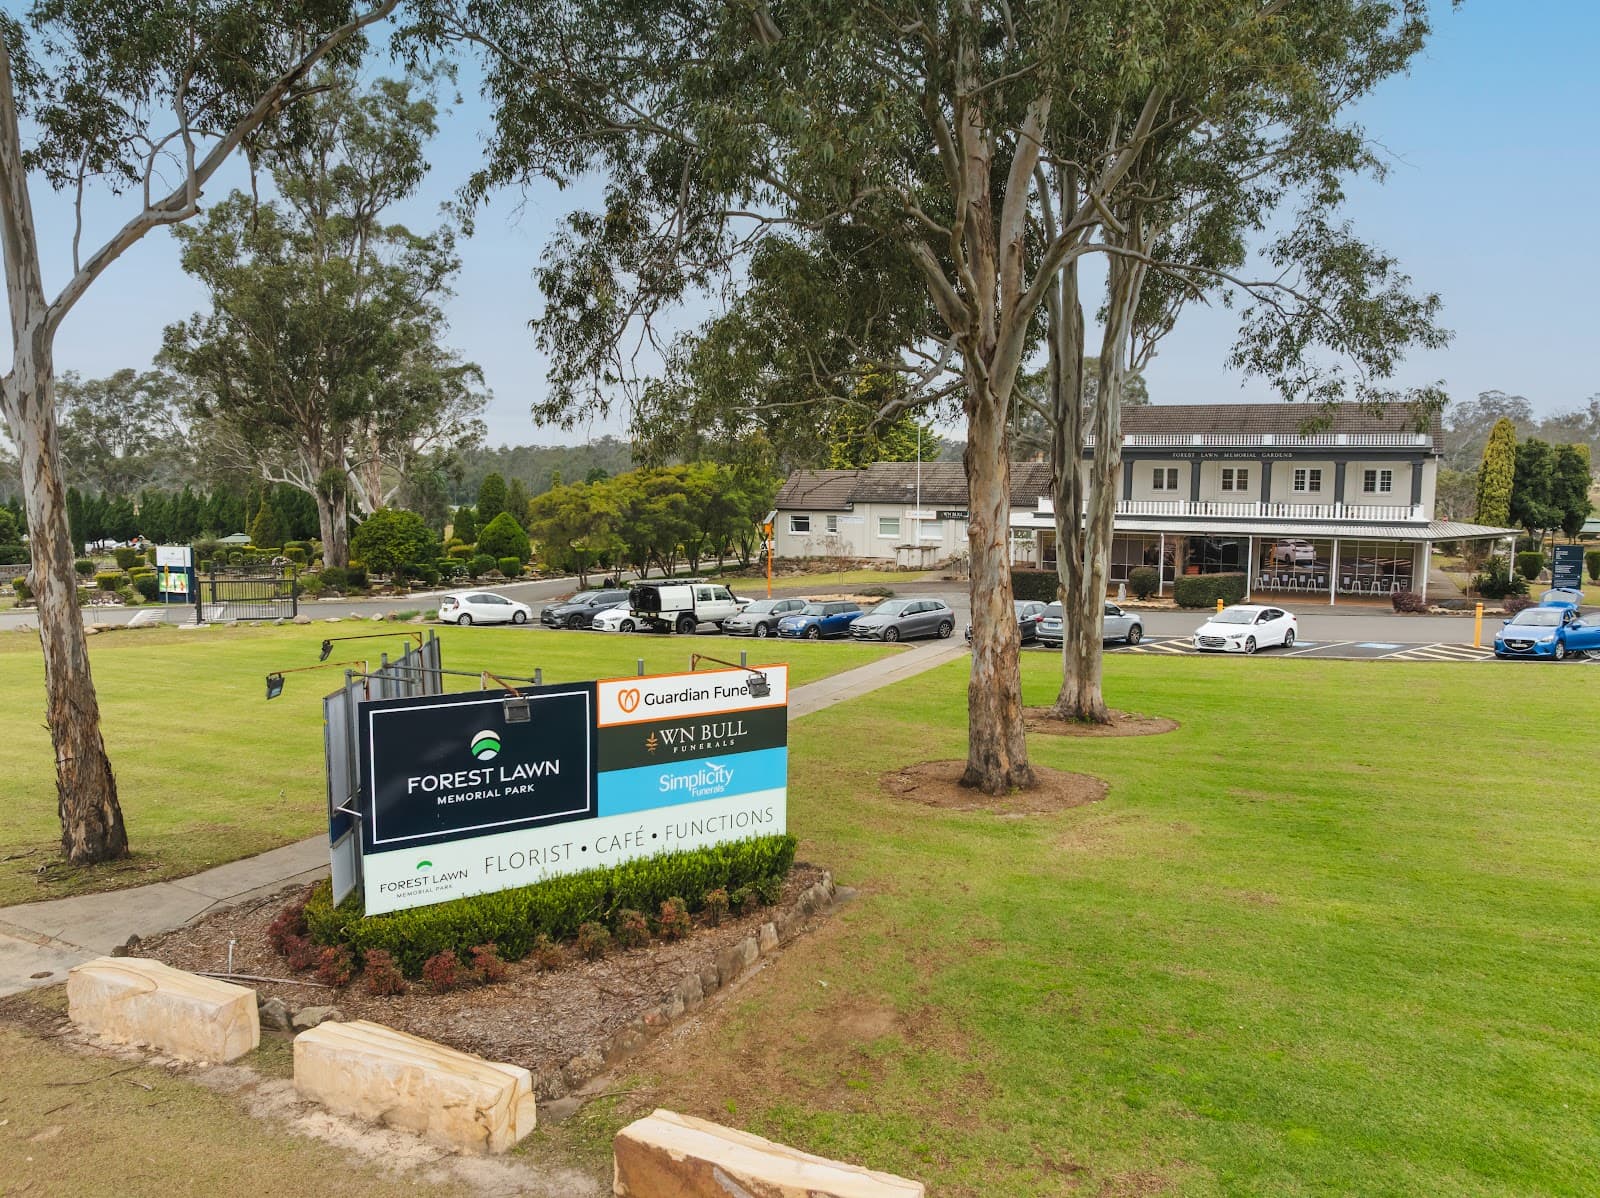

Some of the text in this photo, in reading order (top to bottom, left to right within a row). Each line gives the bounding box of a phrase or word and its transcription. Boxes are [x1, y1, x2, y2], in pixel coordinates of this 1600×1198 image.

[644, 687, 709, 706] Guardian
[660, 720, 748, 745] WN BULL
[673, 739, 736, 753] FUNERALS
[407, 760, 560, 794] FOREST LAWN
[658, 768, 734, 792] Simplicity
[437, 784, 535, 805] MEMORIAL PARK
[691, 785, 725, 797] Funerals
[485, 807, 774, 874] FLORIST CAFÉ FUNCTIONS
[380, 869, 469, 893] FOREST LAWN
[396, 884, 453, 899] MEMORIAL PARK
